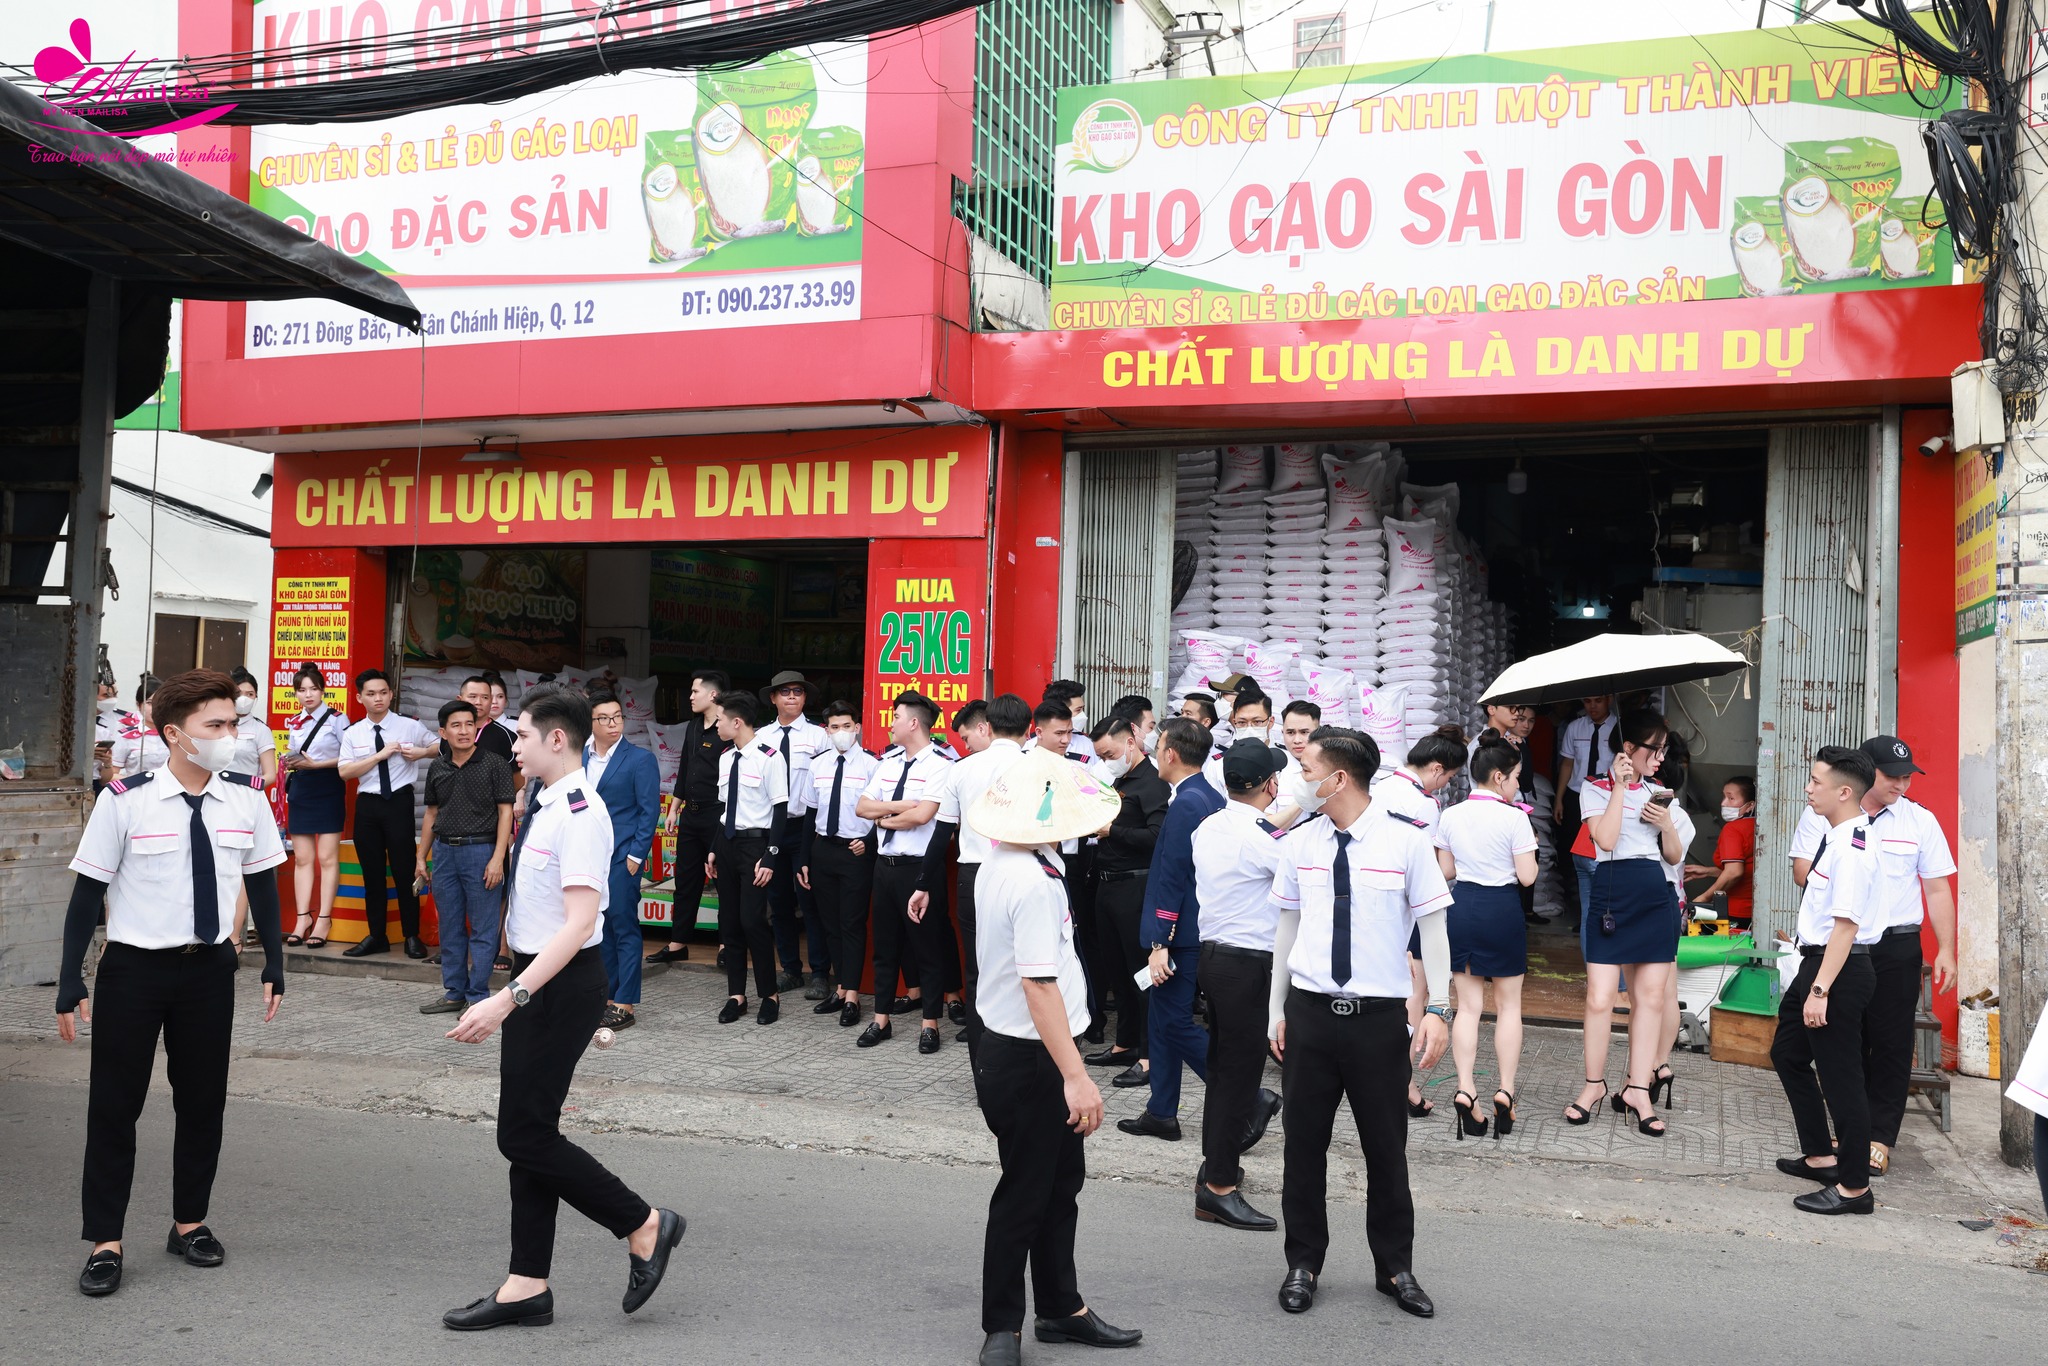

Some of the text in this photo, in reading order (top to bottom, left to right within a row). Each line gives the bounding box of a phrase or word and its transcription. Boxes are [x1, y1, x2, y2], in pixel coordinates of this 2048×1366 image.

[1152, 44, 1940, 148] CÔNG TY TNHH MỘT THÀNH VIÊN
[259, 113, 639, 188] CHUYÊN SỈ & LẺ ĐỦ CÁC LOẠI
[390, 194, 488, 256] ĐẶC
[508, 174, 609, 240] SẢN
[1059, 140, 1724, 268] KHO GẠO SÀI GÒN
[682, 280, 856, 316] ĐT: 090.237.33.99
[1054, 294, 1165, 329] CHUYÊN
[1172, 288, 1203, 323] SỈ
[1208, 296, 1232, 323] &
[1240, 284, 1277, 321] LẺ
[1286, 282, 1328, 319] ĐỦ
[1336, 283, 1398, 318] CÁC
[1636, 265, 1706, 304] SẢN
[252, 325, 278, 347] ĐC:
[283, 322, 310, 345] 271
[316, 321, 353, 345] Đông
[450, 307, 498, 335] Chánh
[504, 305, 544, 334] Hiệp,
[550, 303, 566, 330] Q.
[573, 300, 595, 325] 12
[1102, 323, 1814, 390] CHẤT LƯỢNG LÀ DANH DỰ
[295, 451, 959, 534] CHẤT LƯỢNG LÀ DANH DỰ
[279, 588, 347, 601] KHO GẠO SÀI GÒN
[895, 578, 955, 603] MUA
[277, 613, 347, 626] CHÚNG TÔI NGHỈ VÀO
[878, 610, 971, 675] 25KG
[288, 644, 301, 656] CÁC
[323, 660, 340, 670] HÀNG
[275, 701, 291, 710] KHO
[927, 680, 968, 701] LÊN
